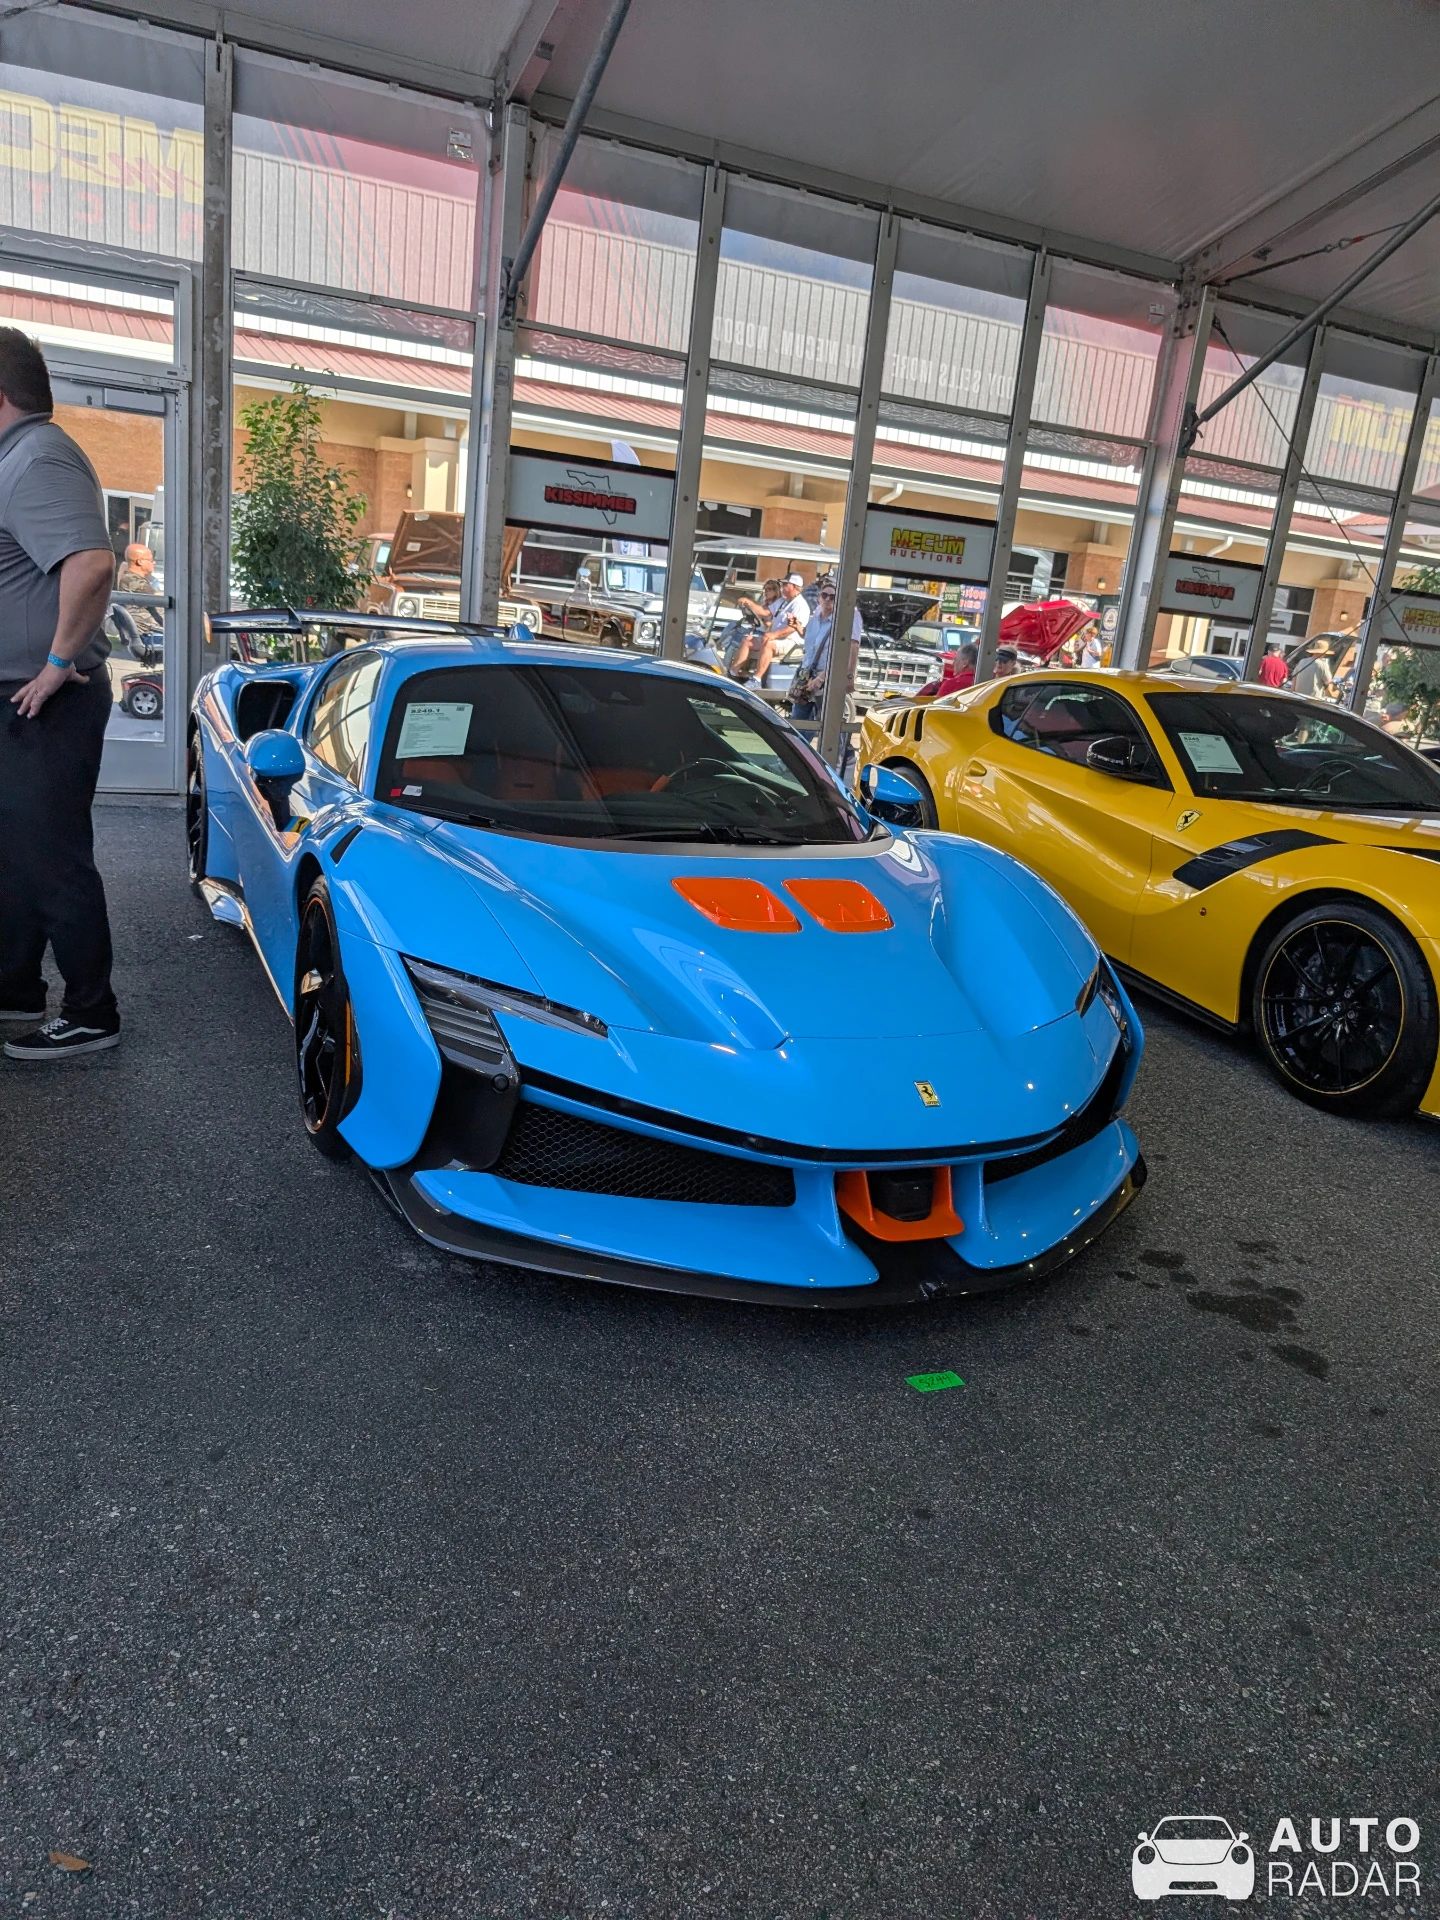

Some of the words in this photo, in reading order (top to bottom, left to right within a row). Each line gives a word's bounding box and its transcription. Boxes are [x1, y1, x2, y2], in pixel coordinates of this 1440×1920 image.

[545, 485, 637, 515] KISSIMMEE
[890, 547, 963, 565] AUCTIONS
[891, 527, 967, 557] MECUM
